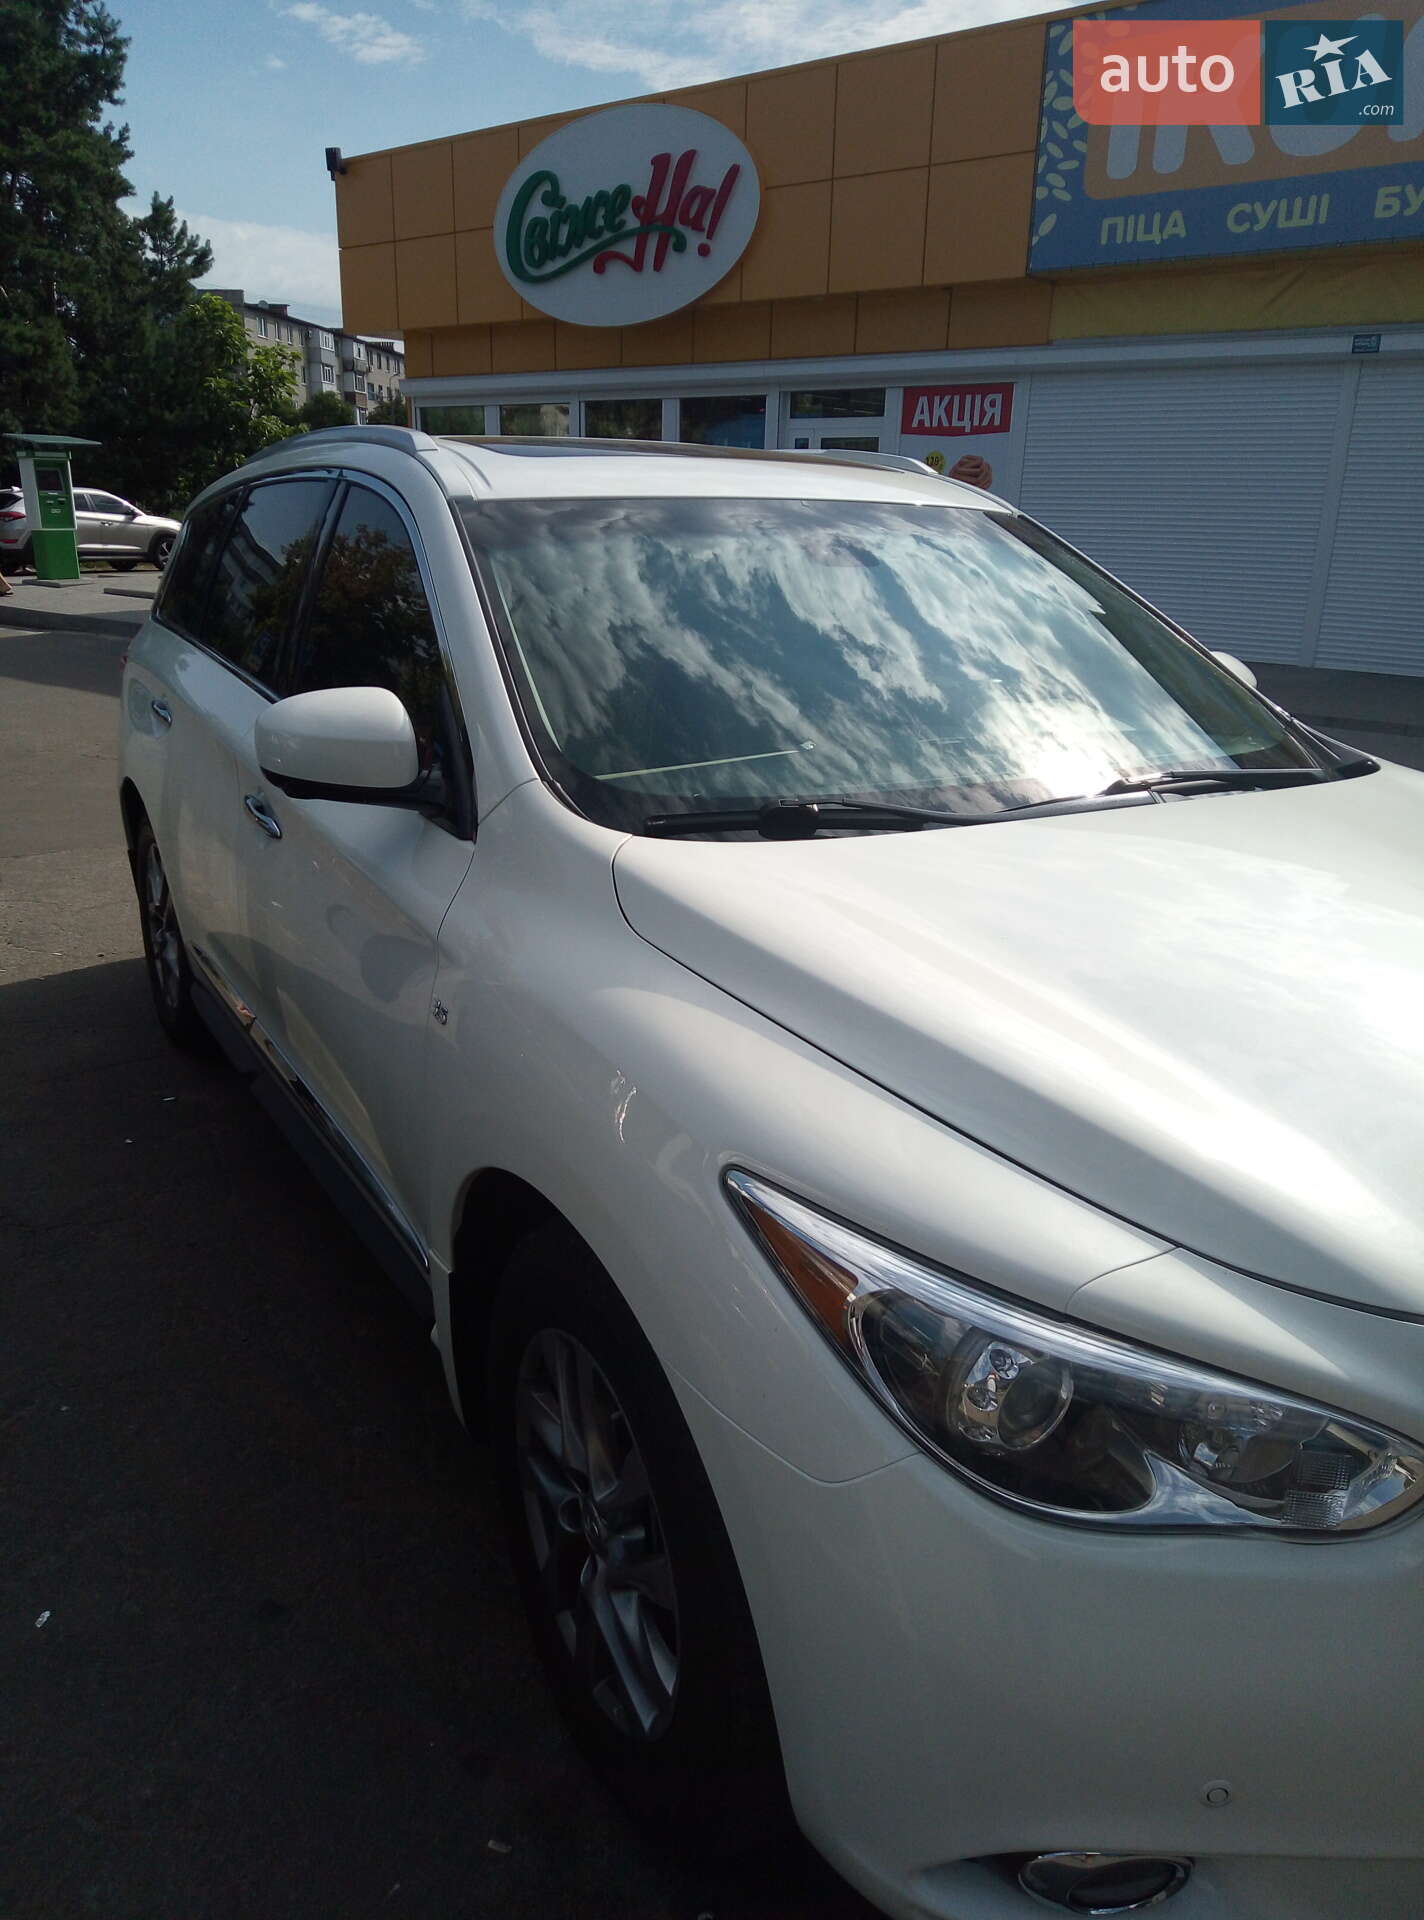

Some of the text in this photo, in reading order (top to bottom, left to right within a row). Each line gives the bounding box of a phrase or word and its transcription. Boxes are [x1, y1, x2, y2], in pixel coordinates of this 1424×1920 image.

[1100, 210, 1187, 246] ПІЦА
[1226, 194, 1330, 233] СУШІ
[911, 392, 1003, 432] АКЦІЯ
